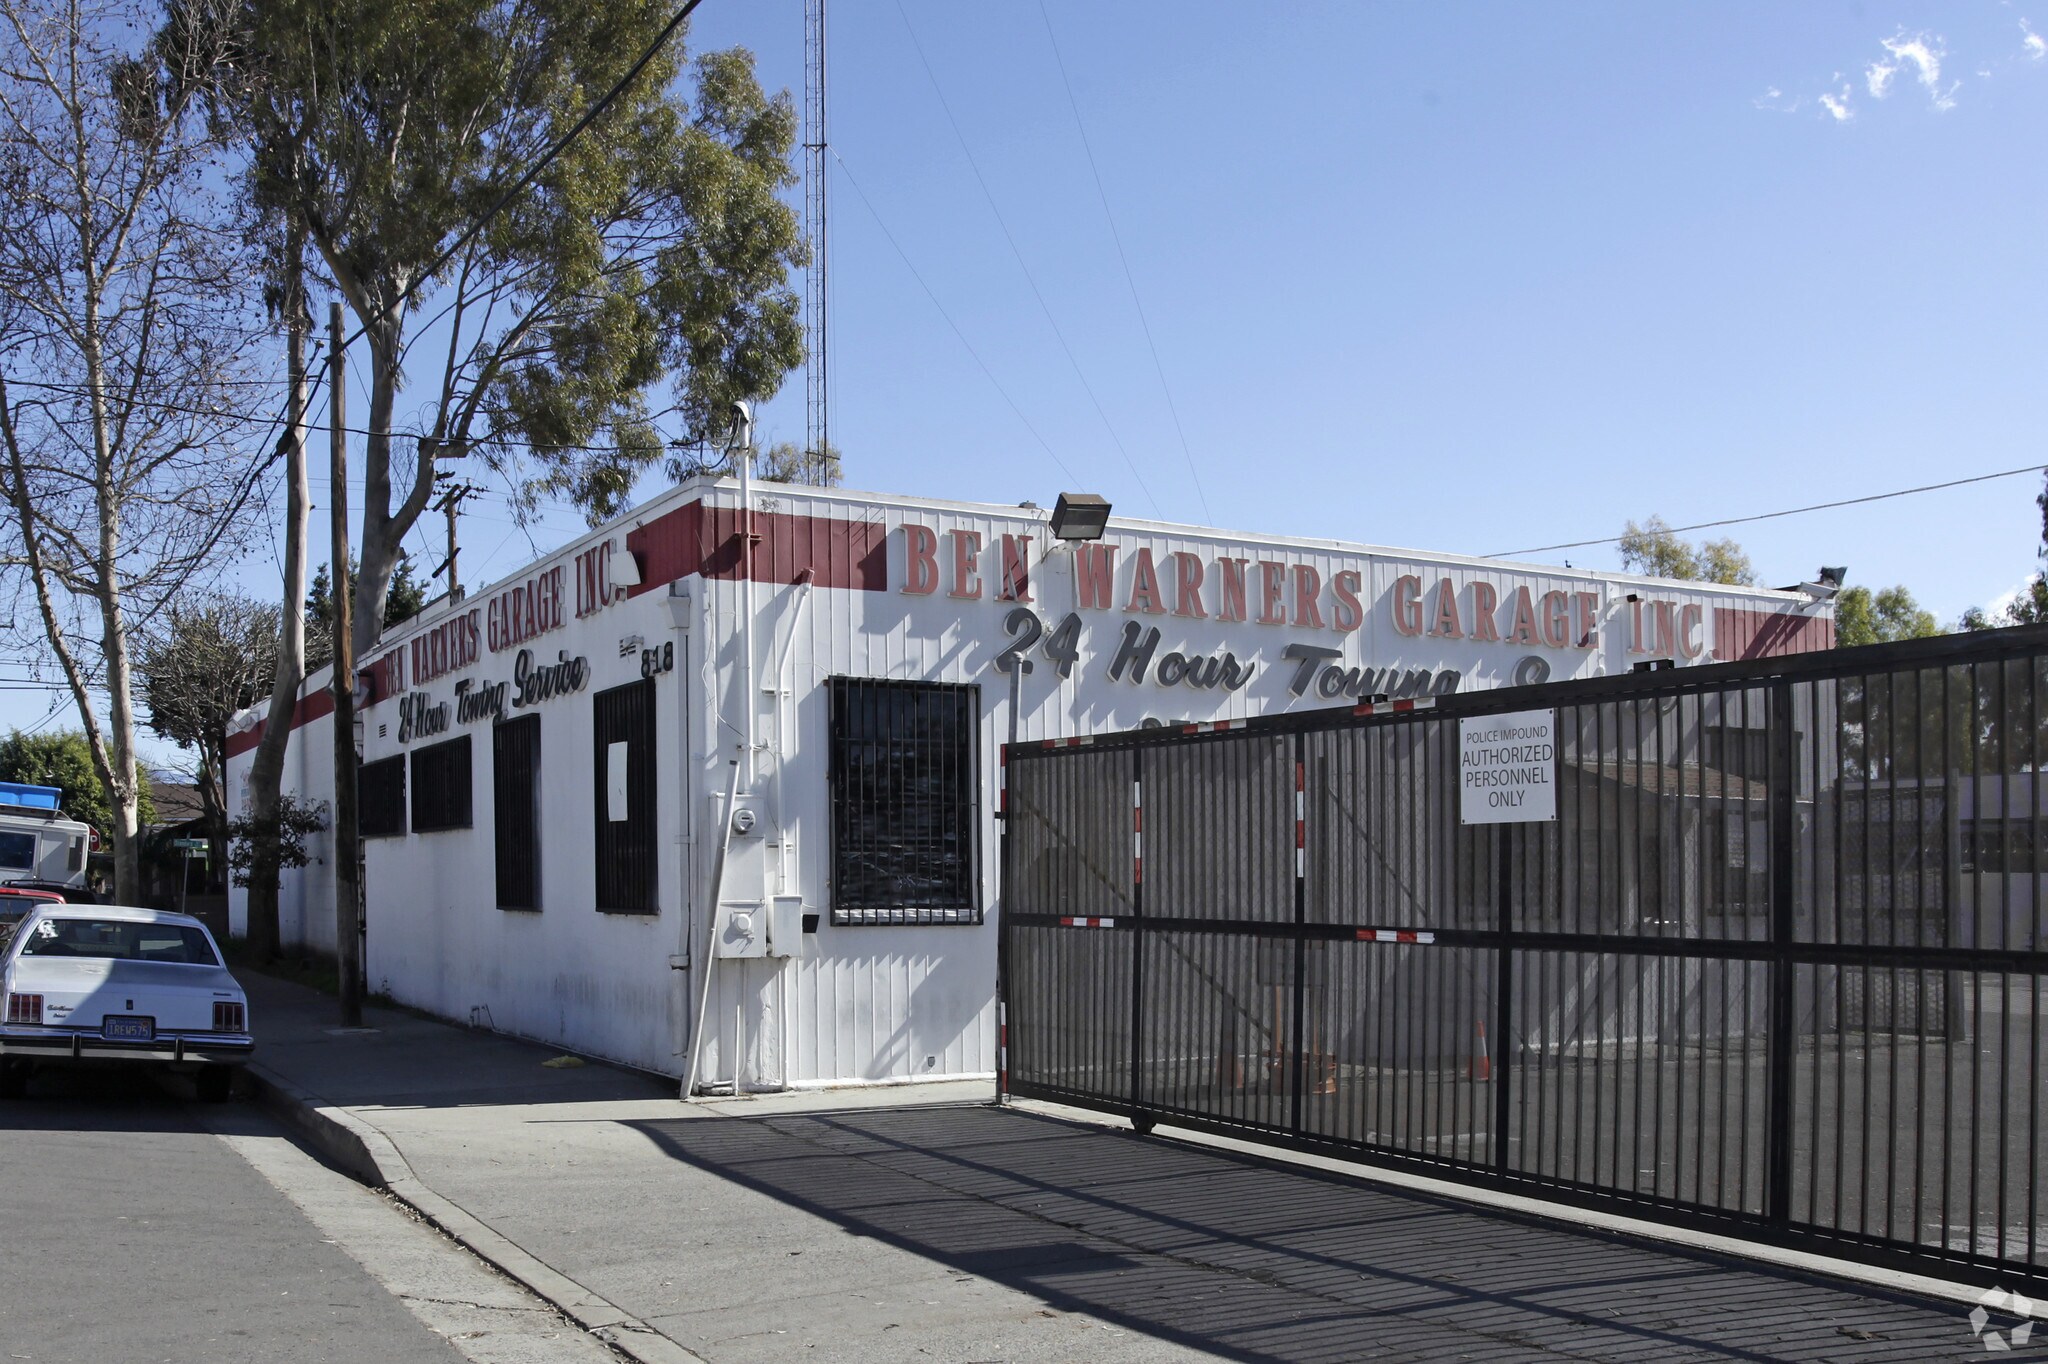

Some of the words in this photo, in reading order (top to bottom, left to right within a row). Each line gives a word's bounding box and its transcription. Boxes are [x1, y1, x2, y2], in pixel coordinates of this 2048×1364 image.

[900, 523, 1034, 602] BEN
[1071, 542, 1363, 632] WARNERS
[1392, 574, 1600, 649] GARAGE
[1627, 599, 1721, 661] INC.
[411, 608, 482, 686] WARNERS
[487, 565, 567, 653] GARAGE
[641, 641, 673, 678] 818
[994, 608, 1083, 680] 24
[1107, 620, 1255, 693] Hour
[398, 692, 418, 743] 24
[416, 692, 452, 739] Hour
[455, 677, 510, 727] Towing
[512, 649, 591, 708] Service
[1466, 730, 1498, 744] POLICE
[1501, 725, 1548, 741] IMPOUND
[1462, 744, 1553, 767] AUTHORIZED
[1466, 767, 1549, 788] PERSONNEL
[1489, 790, 1525, 807] ONLY
[109, 1024, 148, 1037] 1REW575
